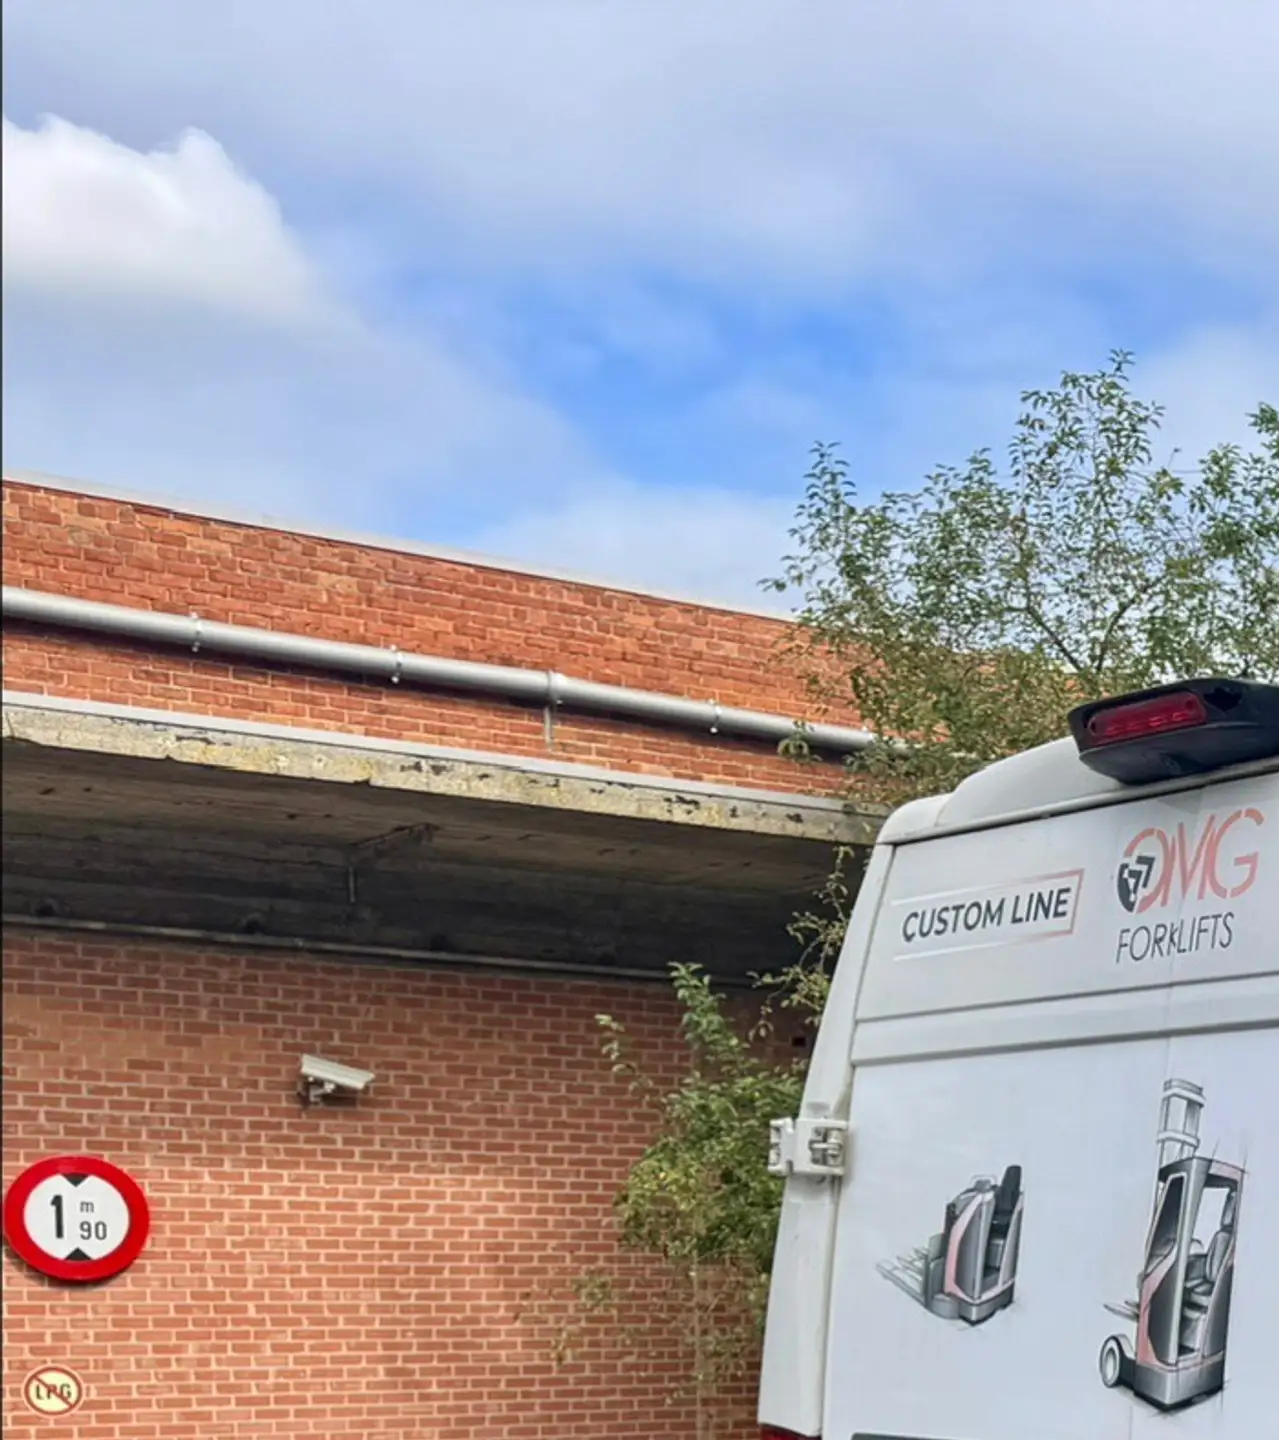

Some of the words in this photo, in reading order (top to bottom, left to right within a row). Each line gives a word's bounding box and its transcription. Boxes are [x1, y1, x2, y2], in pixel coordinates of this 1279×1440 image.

[1117, 808, 1265, 914] OMG
[902, 898, 1006, 943] CUSTOM
[1001, 887, 1071, 924] LINE
[1116, 911, 1235, 964] FORKLIFTS
[50, 1194, 64, 1239] 1
[80, 1200, 94, 1213] m
[79, 1220, 108, 1241] 90
[35, 1383, 72, 1400] LPG
